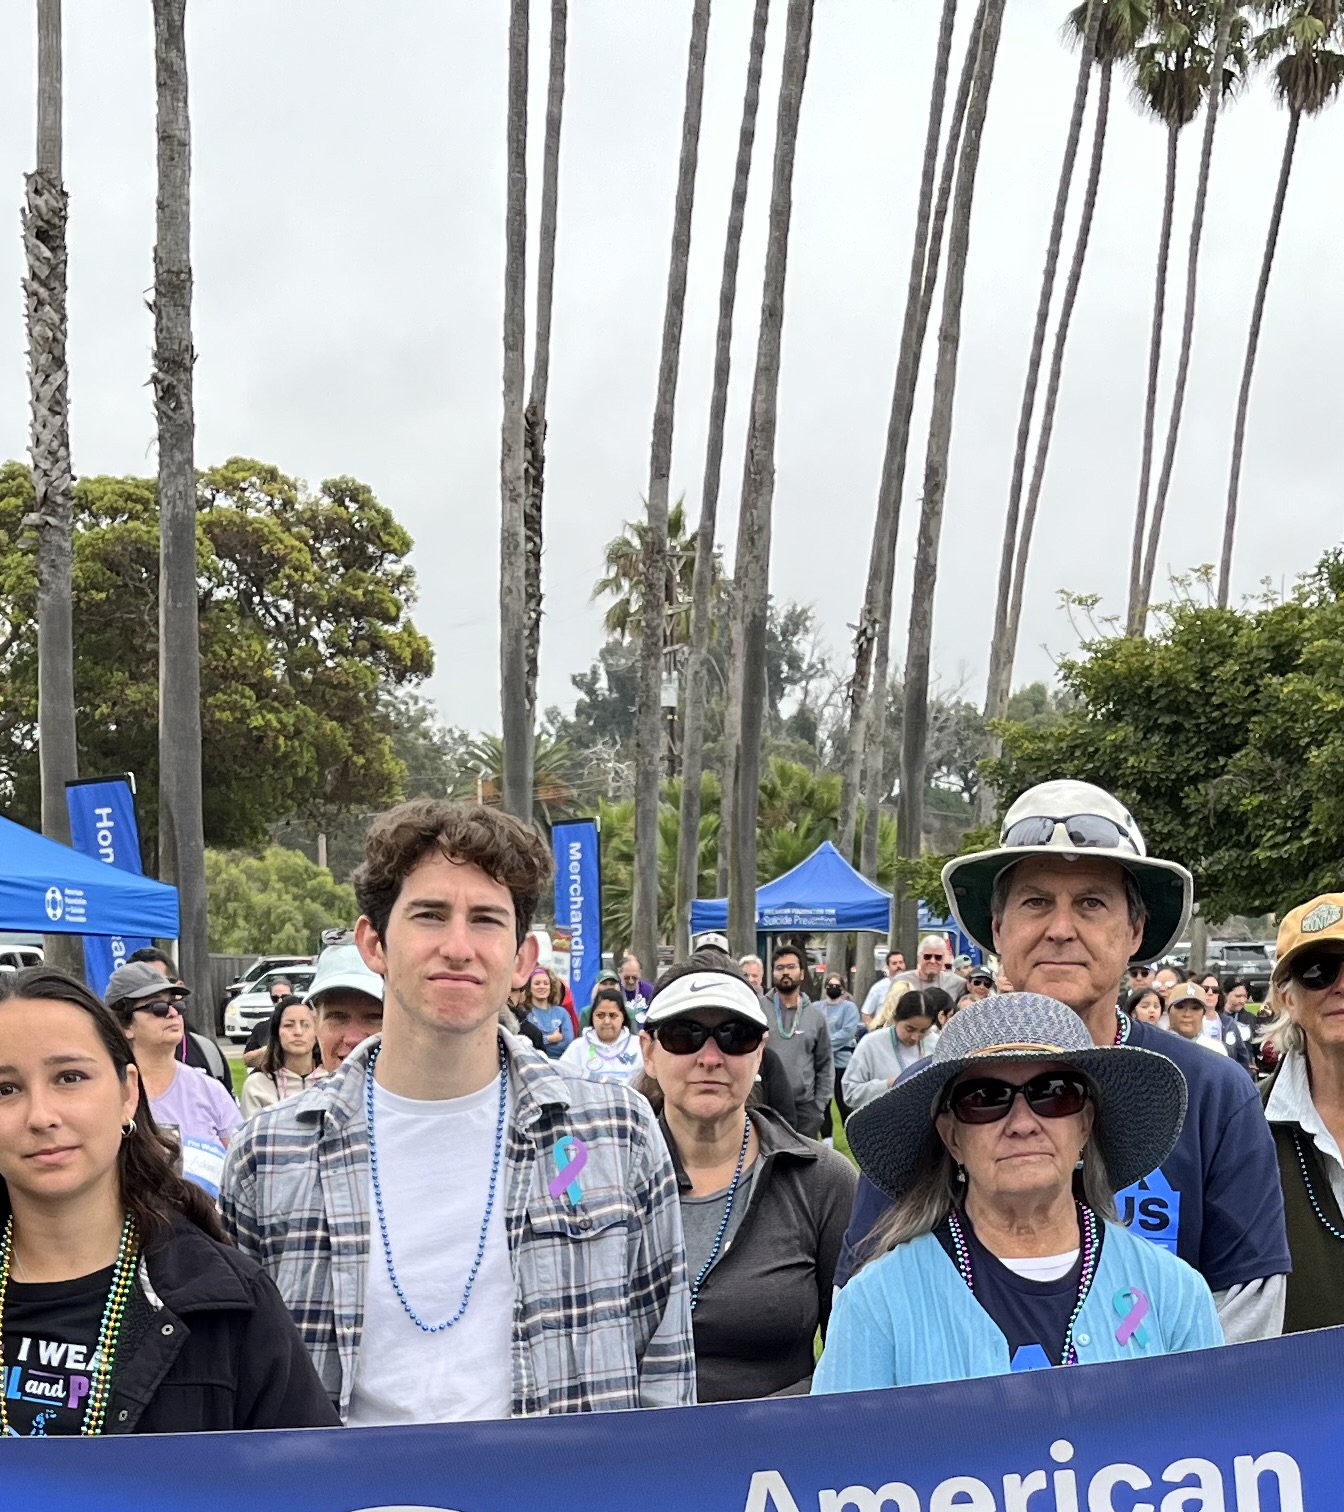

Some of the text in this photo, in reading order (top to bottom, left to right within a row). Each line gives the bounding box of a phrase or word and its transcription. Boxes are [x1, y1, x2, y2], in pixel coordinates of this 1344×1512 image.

[94, 807, 115, 864] Hon
[569, 841, 585, 983] Merchandise
[17, 1337, 32, 1361] I
[24, 1379, 67, 1398] and
